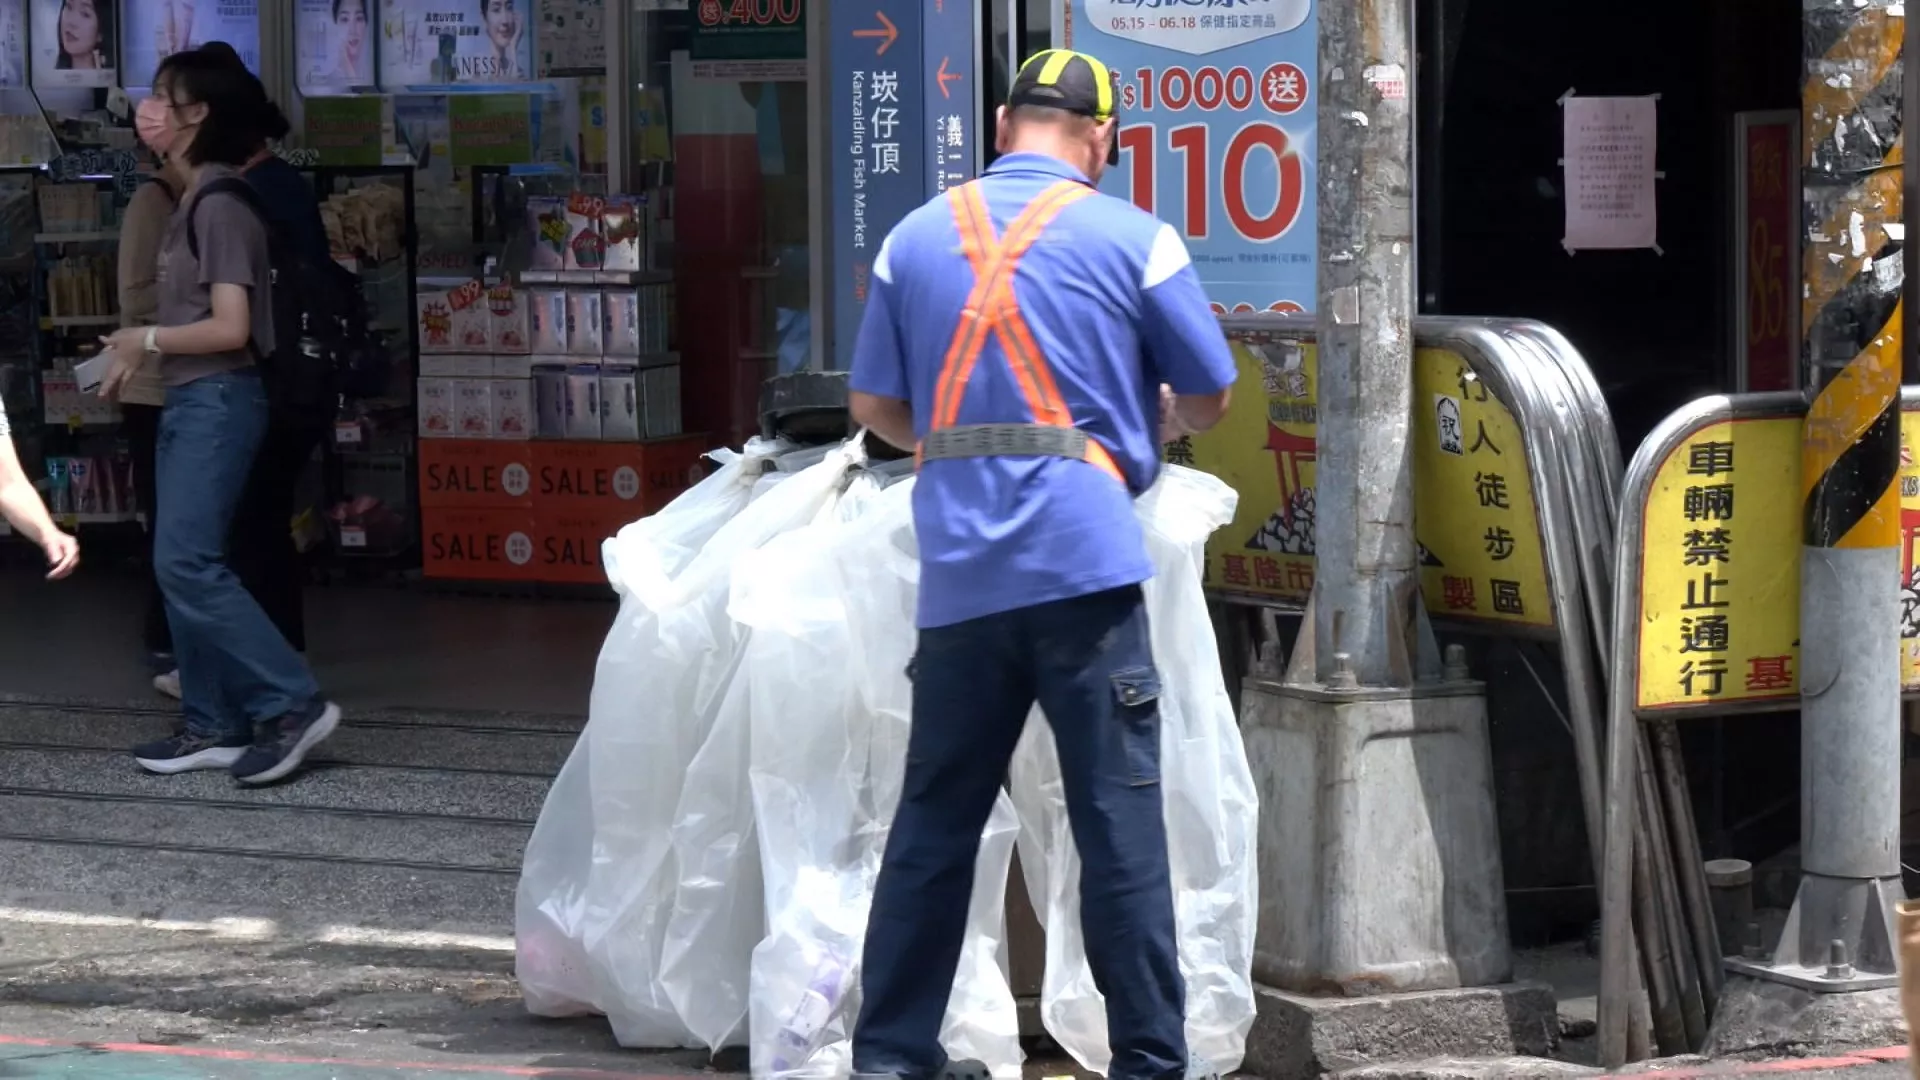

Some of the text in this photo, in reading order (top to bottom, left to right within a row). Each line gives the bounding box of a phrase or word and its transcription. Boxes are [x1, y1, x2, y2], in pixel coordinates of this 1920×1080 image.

[1111, 17, 1145, 30] 05.15
[1159, 16, 1196, 29] 06.18
[1111, 66, 1254, 112] $1000
[871, 70, 900, 174] 崁仔頂
[936, 136, 945, 165] 2nd
[855, 157, 866, 190] Fish
[1118, 123, 1306, 243] 110
[854, 192, 867, 248] Market
[428, 463, 496, 492] SALE
[540, 465, 608, 496] SALE
[1457, 366, 1525, 615] 行人徒步區
[432, 532, 500, 562] SALE
[1221, 553, 1314, 590] 基隆市
[1679, 441, 1734, 697] 車輛禁止通行
[1745, 655, 1793, 691] 基
